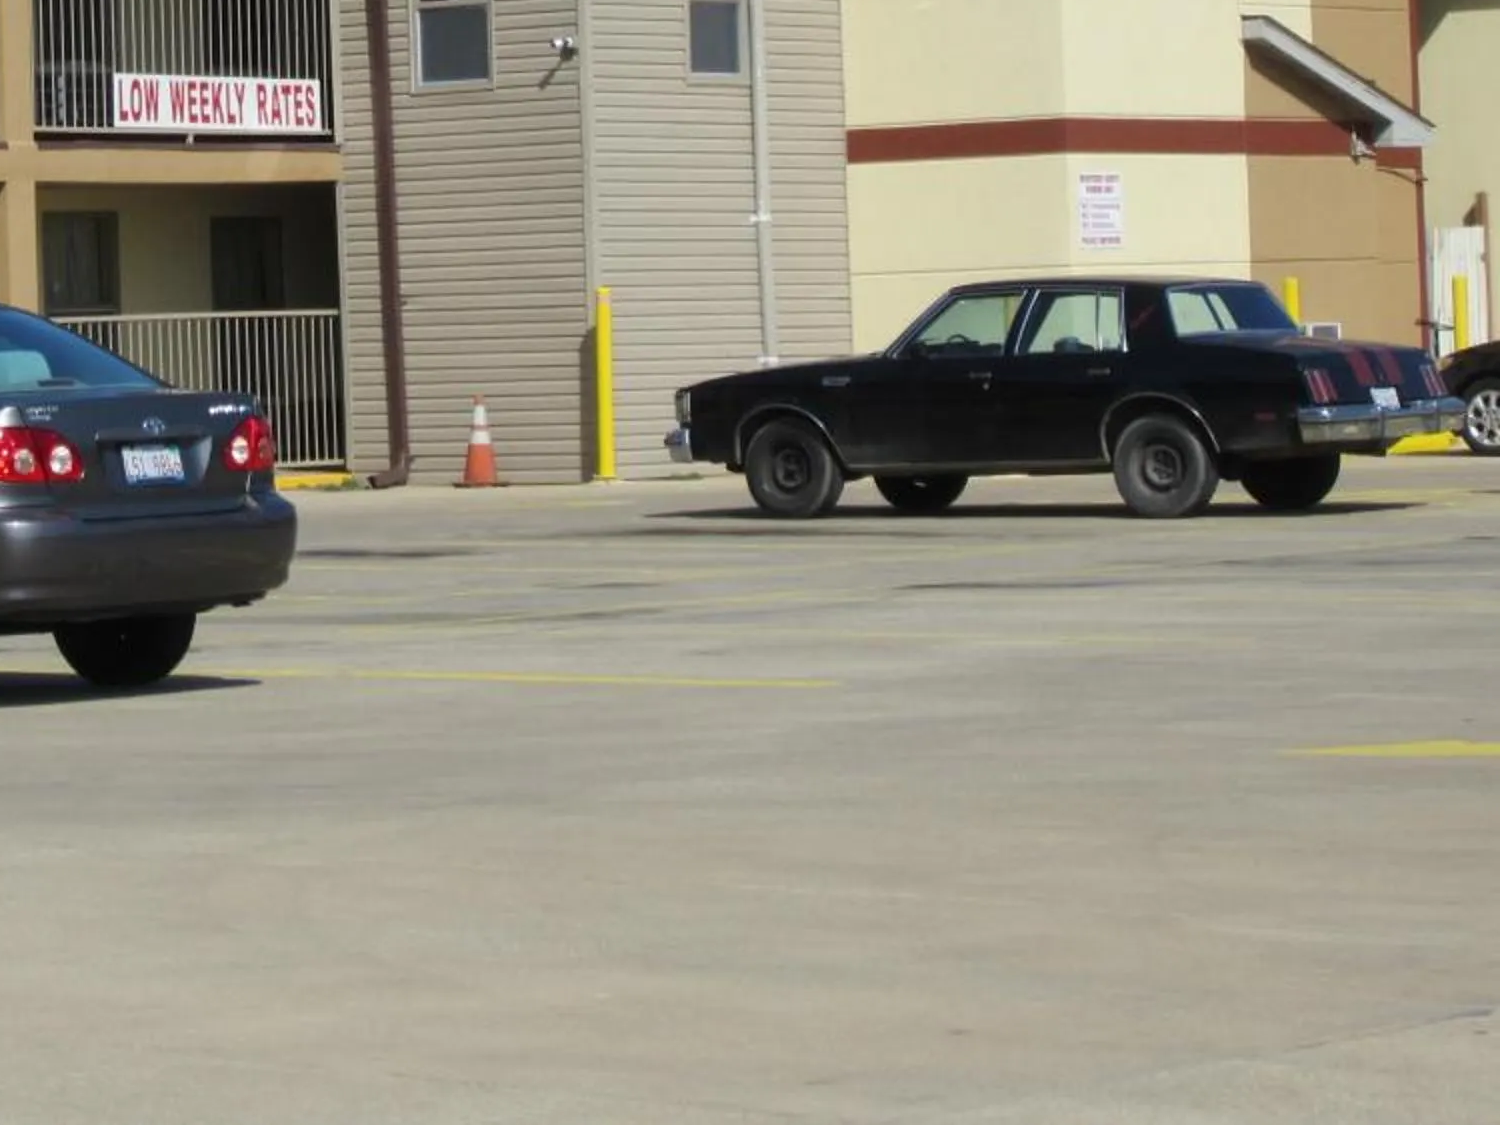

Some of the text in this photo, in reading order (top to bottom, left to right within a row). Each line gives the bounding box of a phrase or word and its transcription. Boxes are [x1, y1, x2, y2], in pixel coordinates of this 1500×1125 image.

[118, 78, 316, 127] LOW WEEKLY RATES
